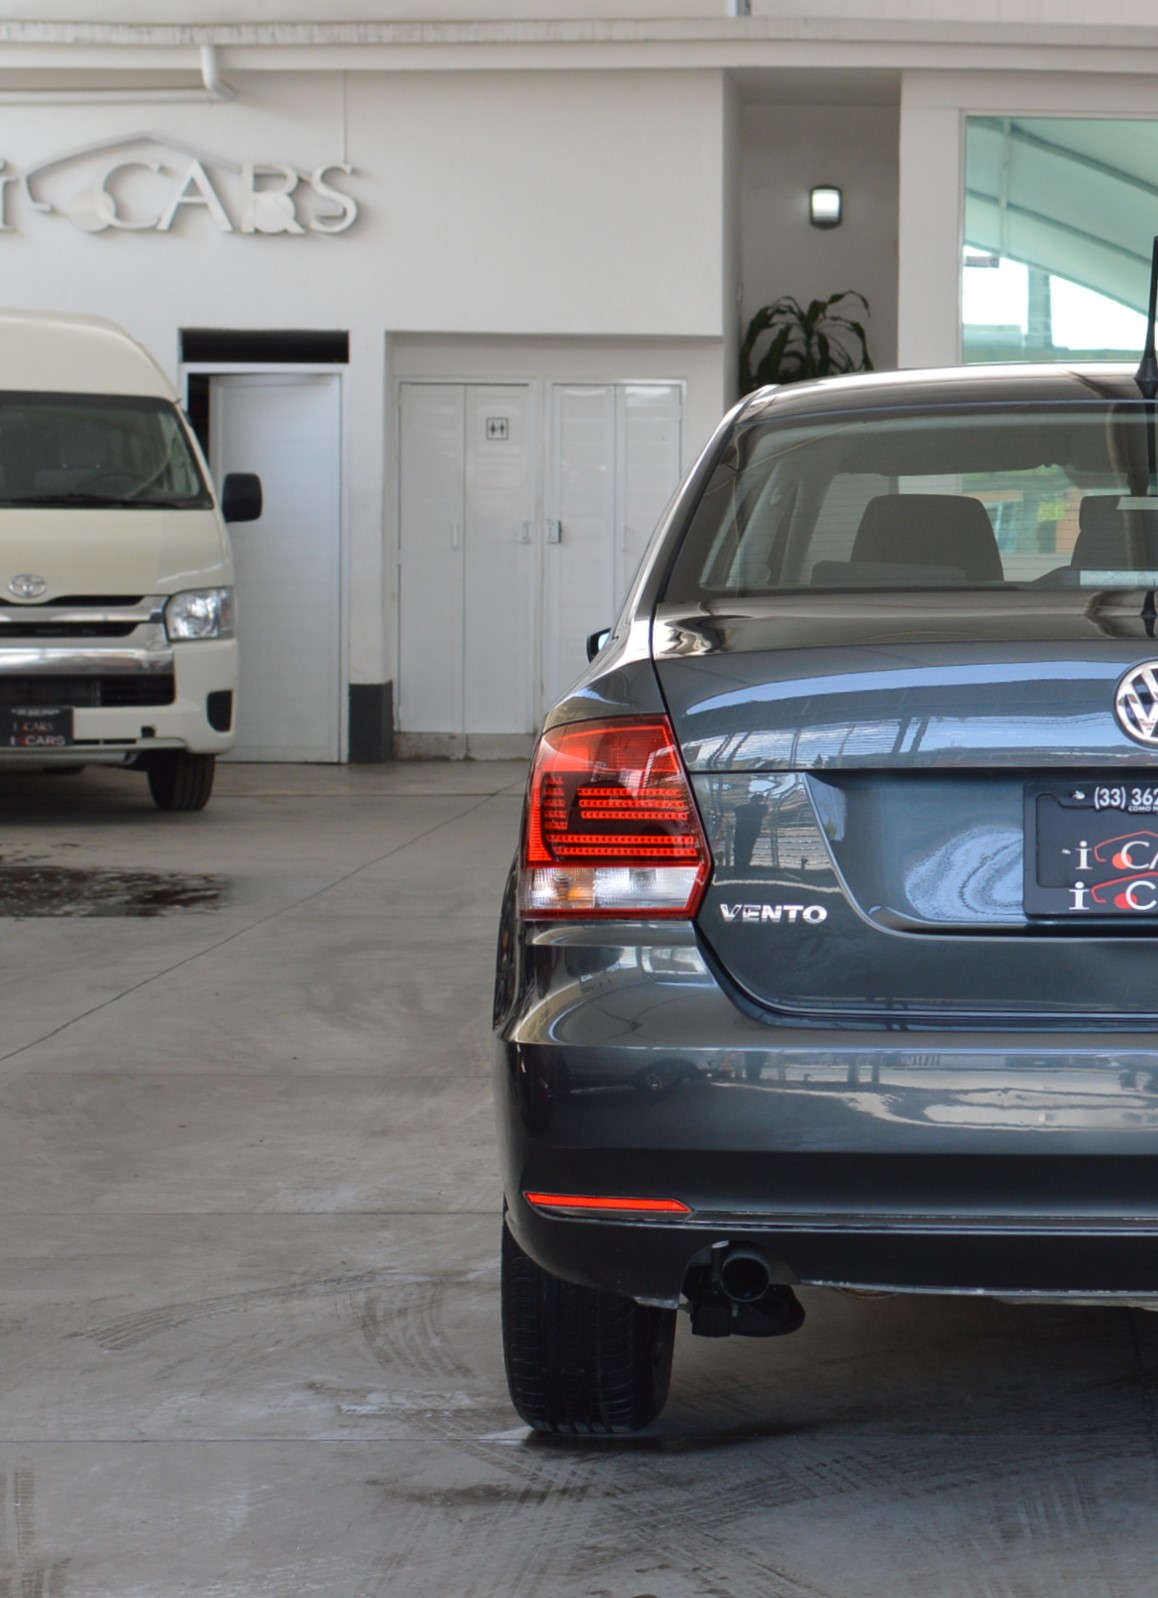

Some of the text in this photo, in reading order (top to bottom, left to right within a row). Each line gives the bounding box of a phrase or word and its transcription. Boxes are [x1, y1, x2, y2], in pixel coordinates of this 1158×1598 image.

[102, 159, 357, 234] CARS
[1094, 786, 1126, 809] (33)
[720, 904, 828, 924] VENTO
